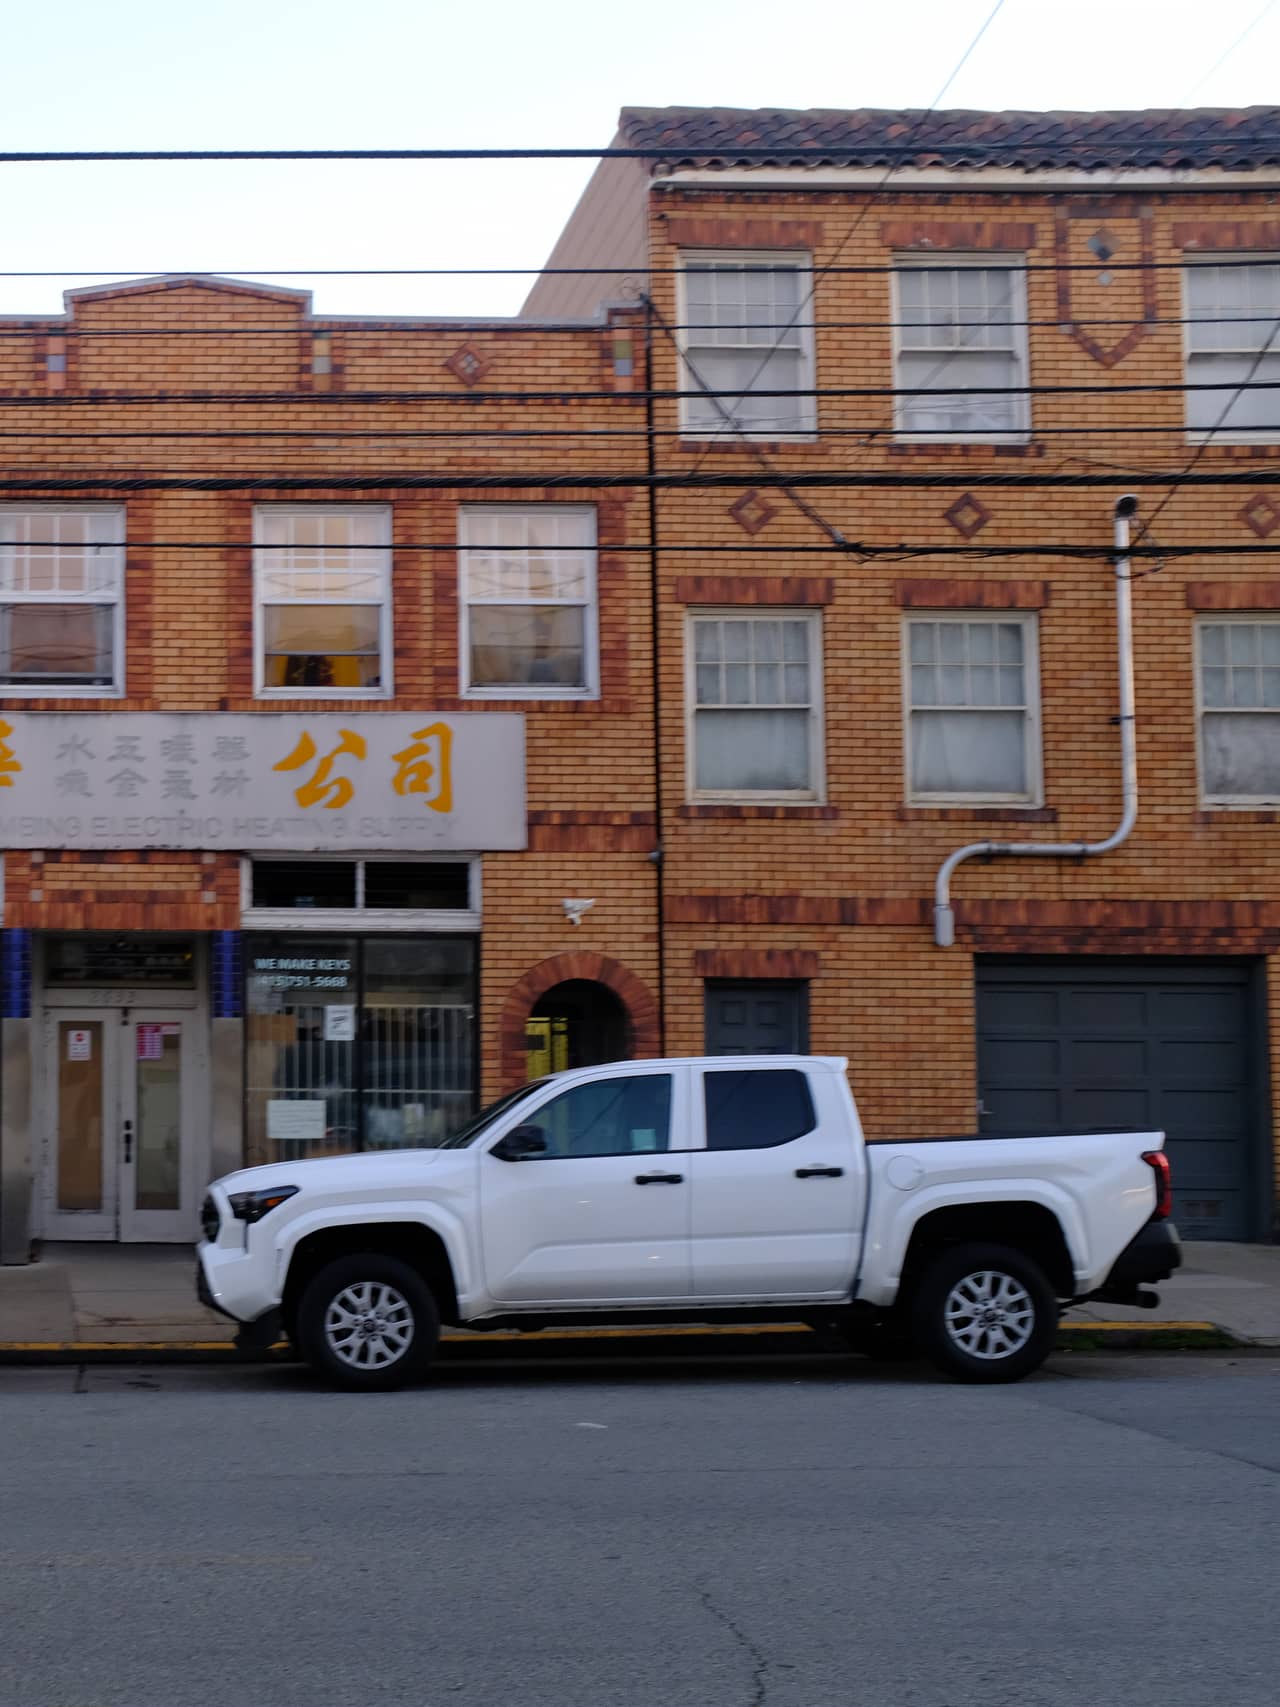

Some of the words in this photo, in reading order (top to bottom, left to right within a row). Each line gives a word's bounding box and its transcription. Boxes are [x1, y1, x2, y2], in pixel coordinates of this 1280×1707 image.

[272, 722, 453, 814] 公司
[92, 815, 223, 839] ELECTRIC
[232, 816, 348, 839] HEATING
[360, 816, 456, 838] SUPPLY
[255, 958, 277, 970] WE
[280, 958, 317, 970] MAKE
[320, 959, 351, 970] KEYS
